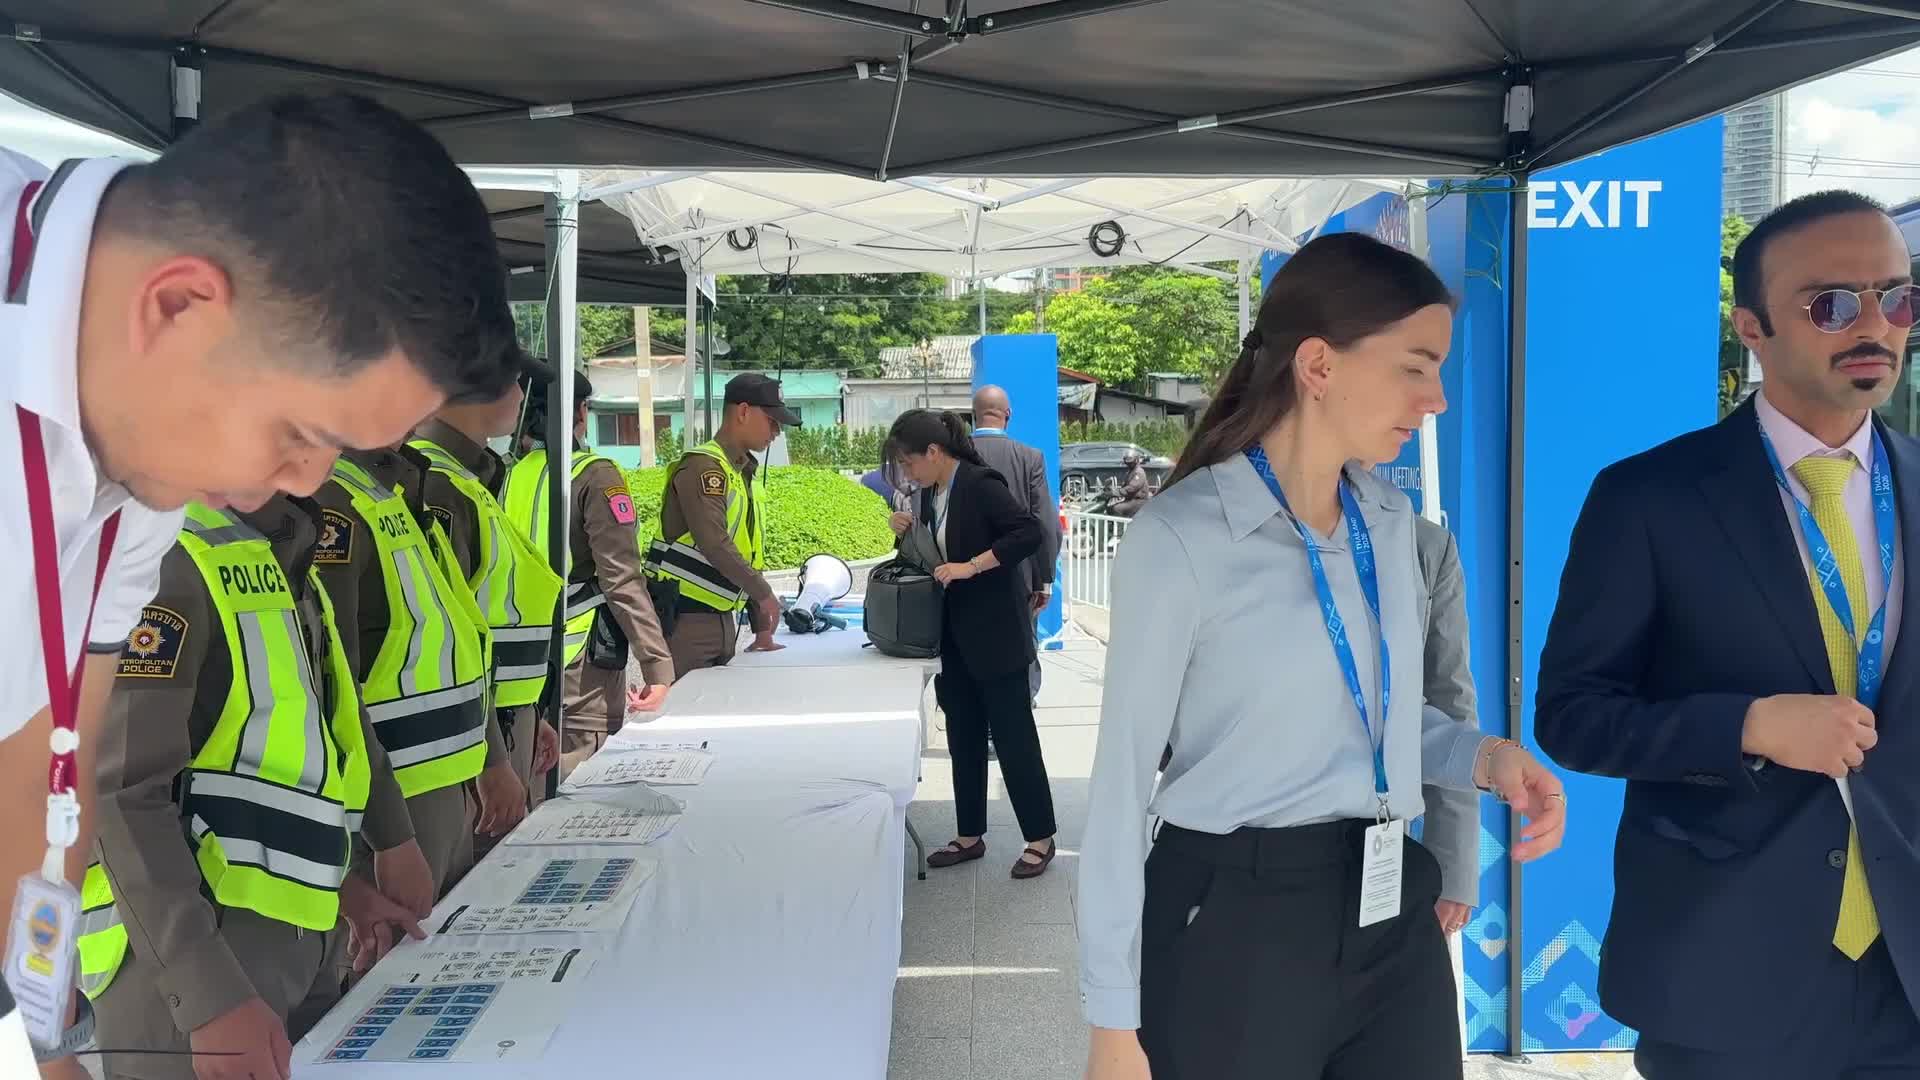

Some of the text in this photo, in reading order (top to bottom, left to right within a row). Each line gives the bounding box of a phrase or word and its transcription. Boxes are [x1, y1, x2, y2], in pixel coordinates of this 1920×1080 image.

[1527, 180, 1662, 228] EXIT
[1391, 466, 1423, 489] MEETING
[218, 563, 286, 596] POLICE
[120, 658, 173, 666] ETROPOLITAN
[123, 665, 162, 673] POLICE
[53, 760, 64, 793] Polic
